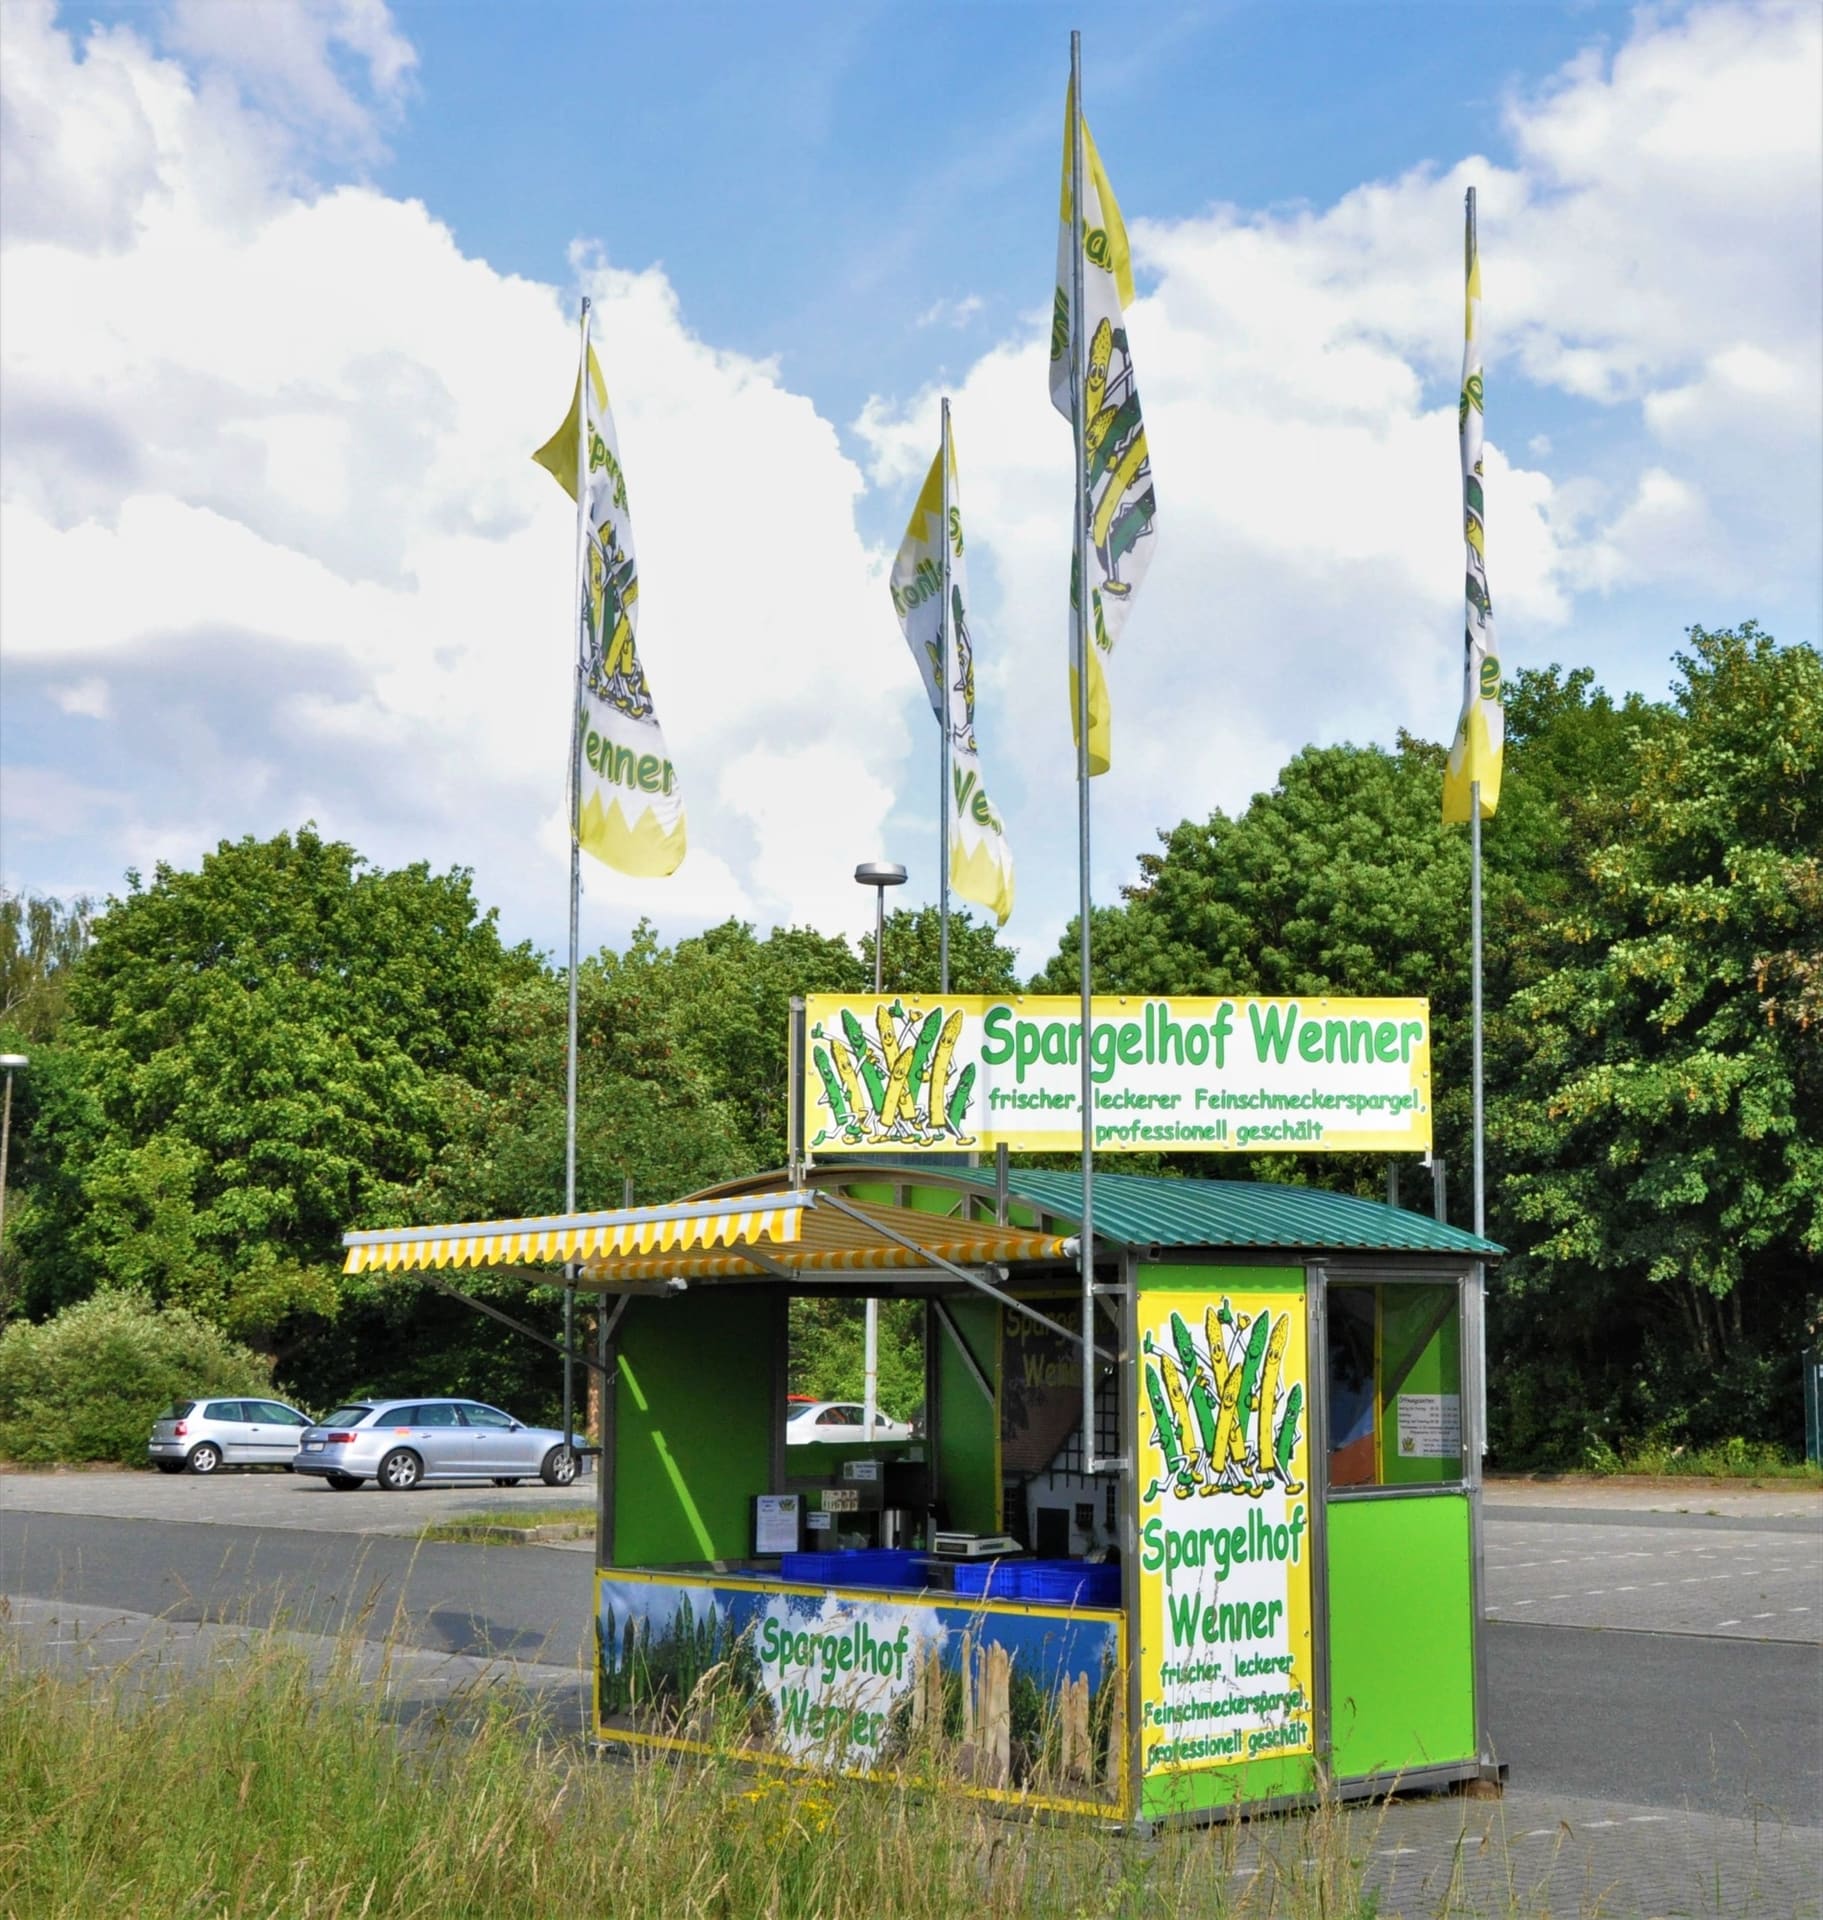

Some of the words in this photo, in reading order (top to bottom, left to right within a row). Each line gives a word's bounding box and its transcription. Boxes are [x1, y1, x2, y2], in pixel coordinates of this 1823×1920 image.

[981, 1002, 1234, 1082] Spargelhof
[1250, 1004, 1422, 1064] Wenner
[1094, 1088, 1182, 1110] leckerer
[1195, 1088, 1426, 1115] Feinschmeckerspargel,
[1095, 1119, 1228, 1146] professionell
[1236, 1119, 1324, 1146] geschält
[1142, 1505, 1305, 1586] Spargelhof
[1168, 1591, 1283, 1648] Wenner
[760, 1616, 910, 1685] Spargelhof
[1234, 1651, 1294, 1677] leckerer
